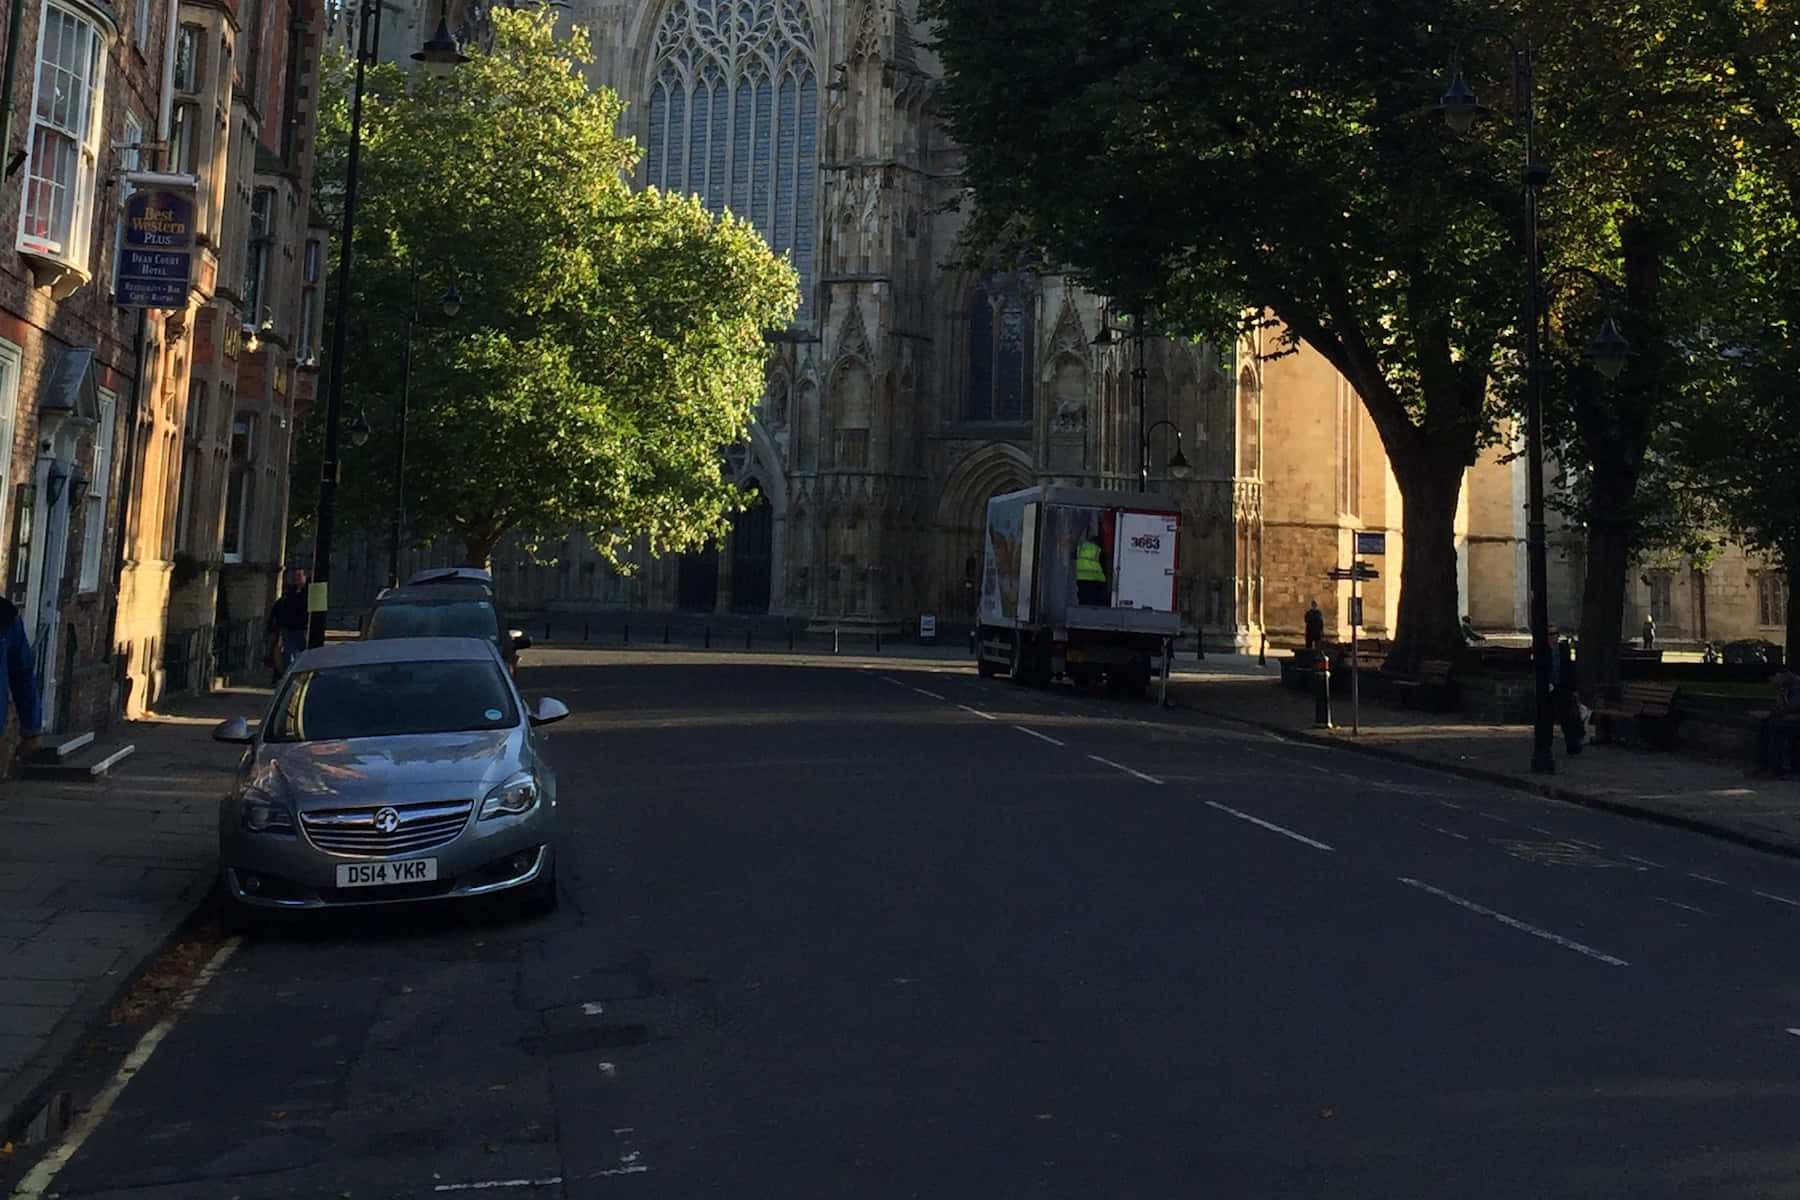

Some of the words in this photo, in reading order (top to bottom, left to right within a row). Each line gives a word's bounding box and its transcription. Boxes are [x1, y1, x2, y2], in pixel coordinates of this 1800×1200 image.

[145, 208, 174, 220] Best
[133, 217, 184, 233] Western
[144, 232, 172, 244] PLUS
[132, 253, 153, 263] DEAN
[154, 254, 180, 265] COURT
[141, 264, 168, 275] HOTEL
[348, 865, 386, 882] DS14
[393, 861, 426, 879] YKR
